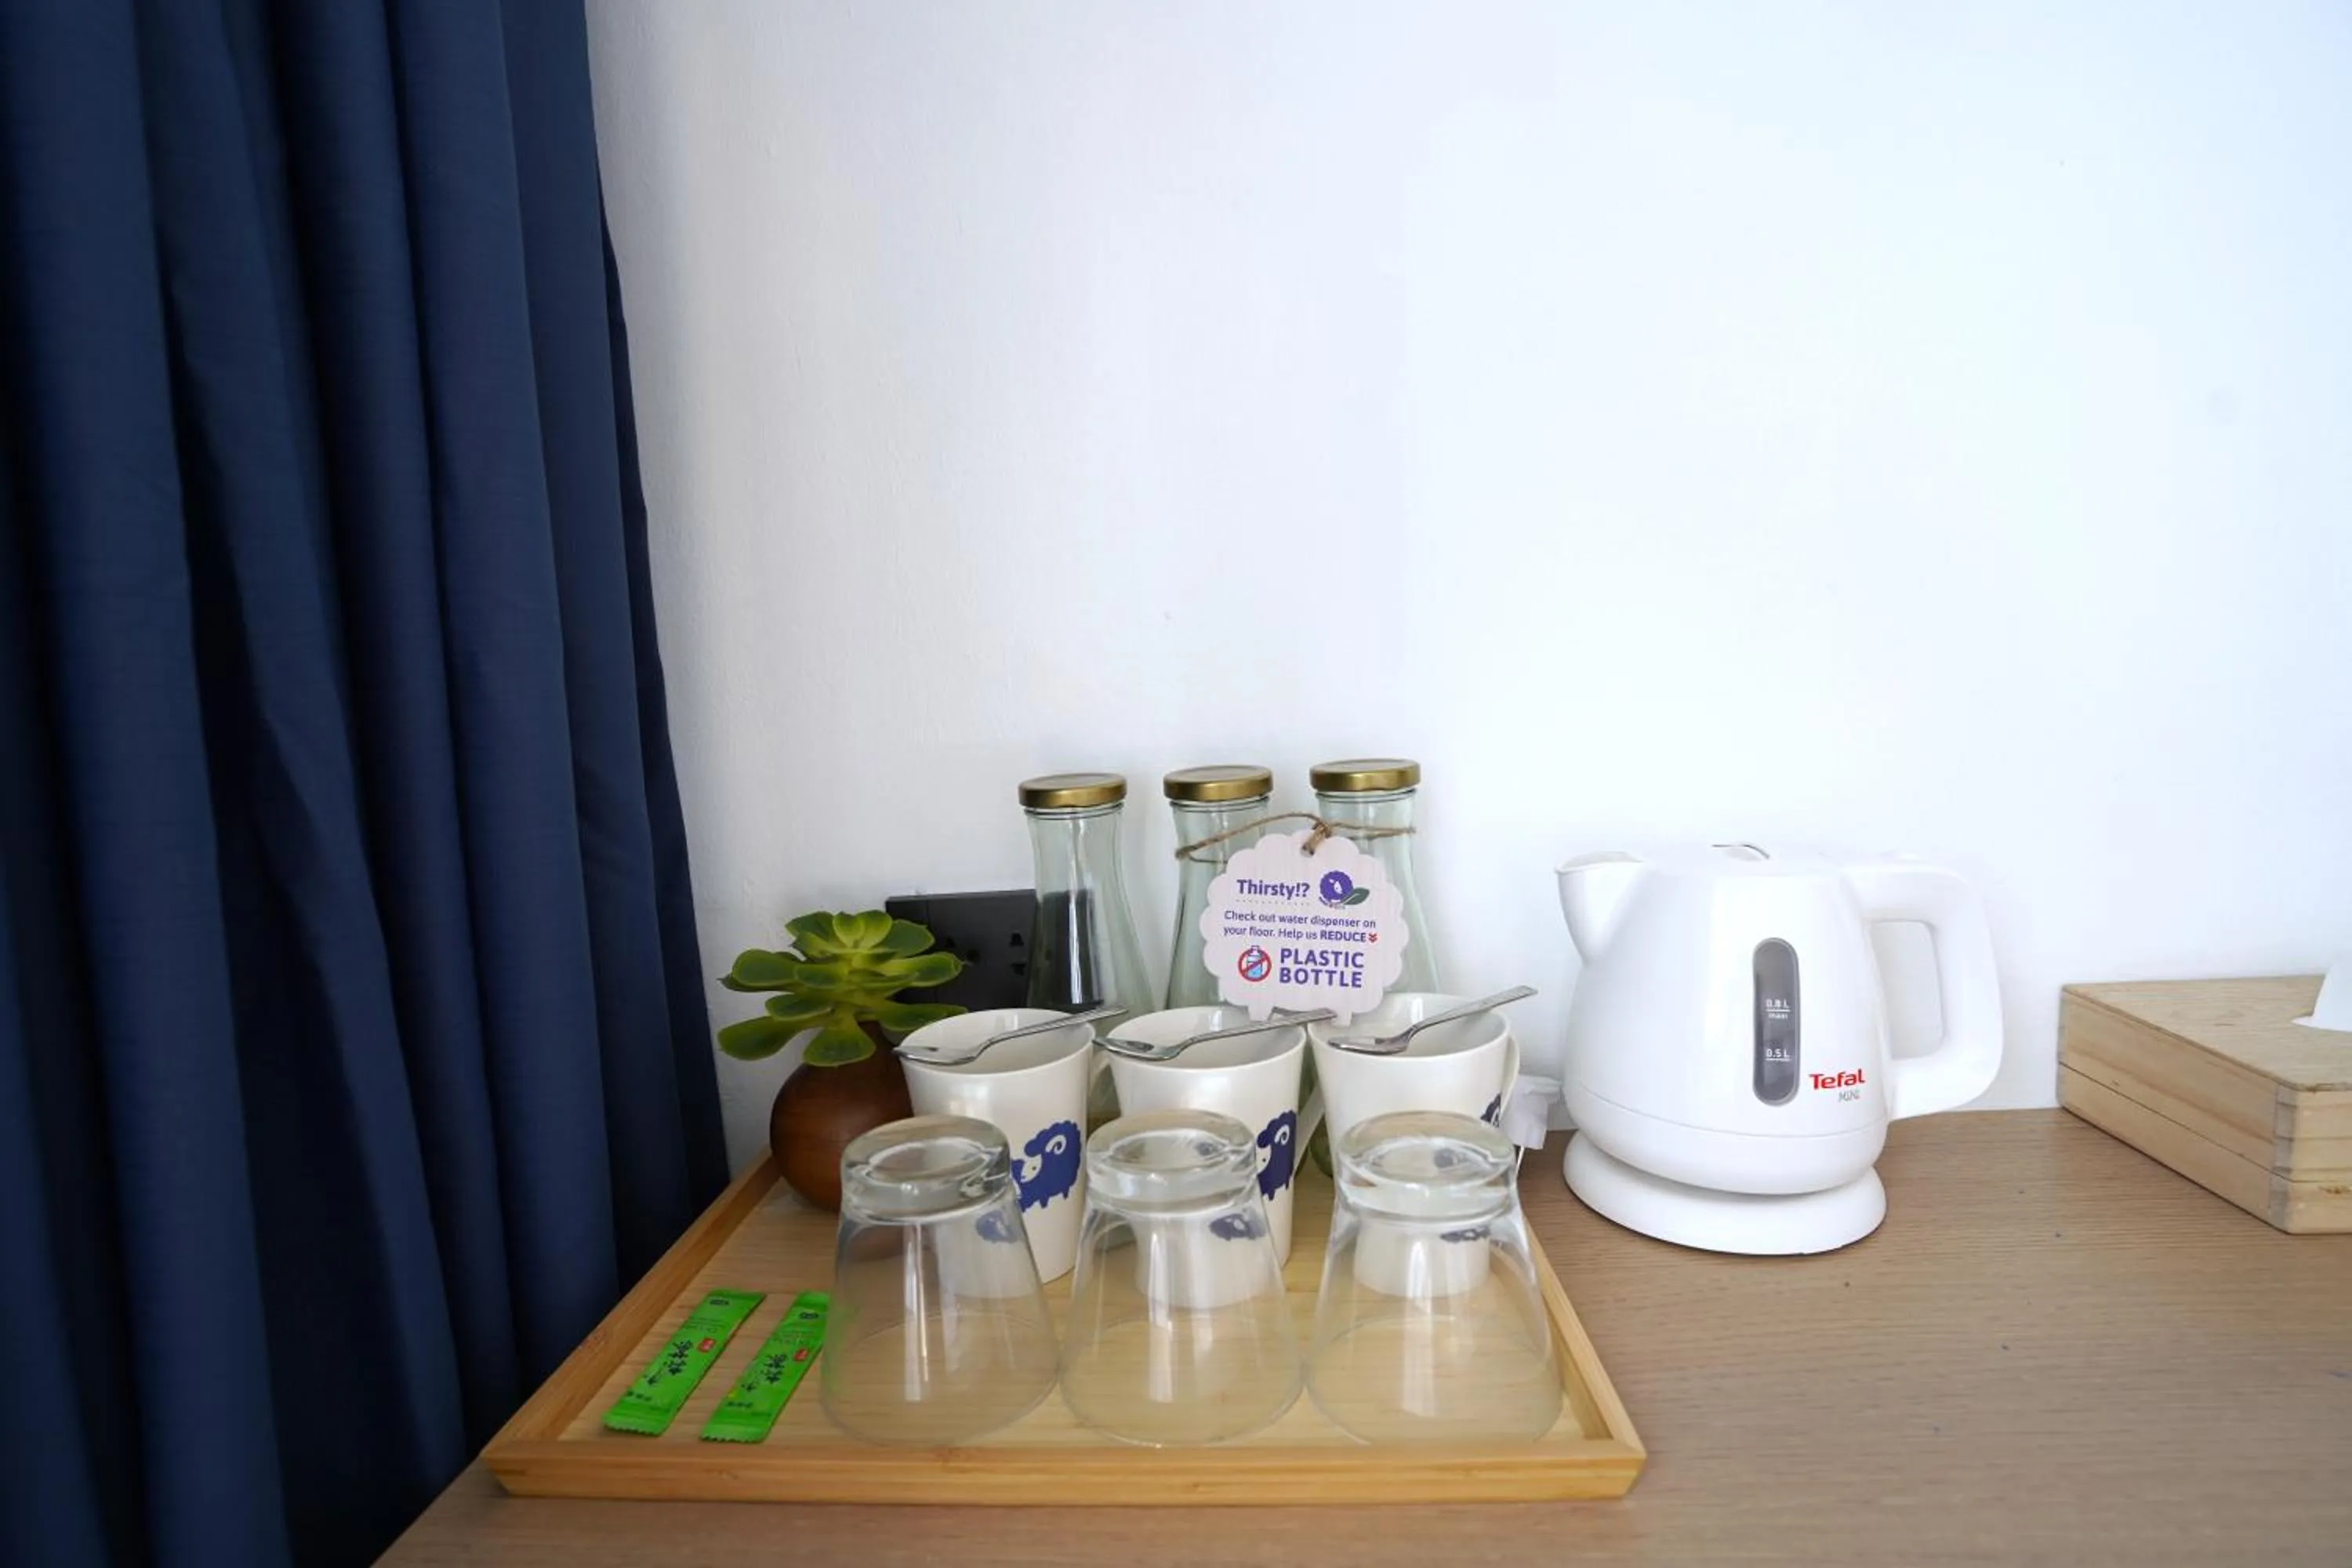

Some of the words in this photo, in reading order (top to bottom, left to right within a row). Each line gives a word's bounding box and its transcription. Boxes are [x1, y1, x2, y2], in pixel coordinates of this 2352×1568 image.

[1236, 879, 1310, 900] Thirsty!?
[1224, 910, 1256, 922] Check
[1258, 912, 1276, 923] out
[1279, 914, 1308, 925] water
[1310, 915, 1359, 929] dispenser
[1363, 920, 1376, 928] on
[1224, 926, 1247, 937] your
[1249, 925, 1275, 937] floor.
[1278, 928, 1303, 941] Help
[1306, 931, 1317, 940] us
[1319, 930, 1367, 942] REDUCE
[1279, 948, 1364, 968] PLASTIC
[1279, 967, 1363, 989] BOTTLE
[1809, 1069, 1866, 1090] Tefal
